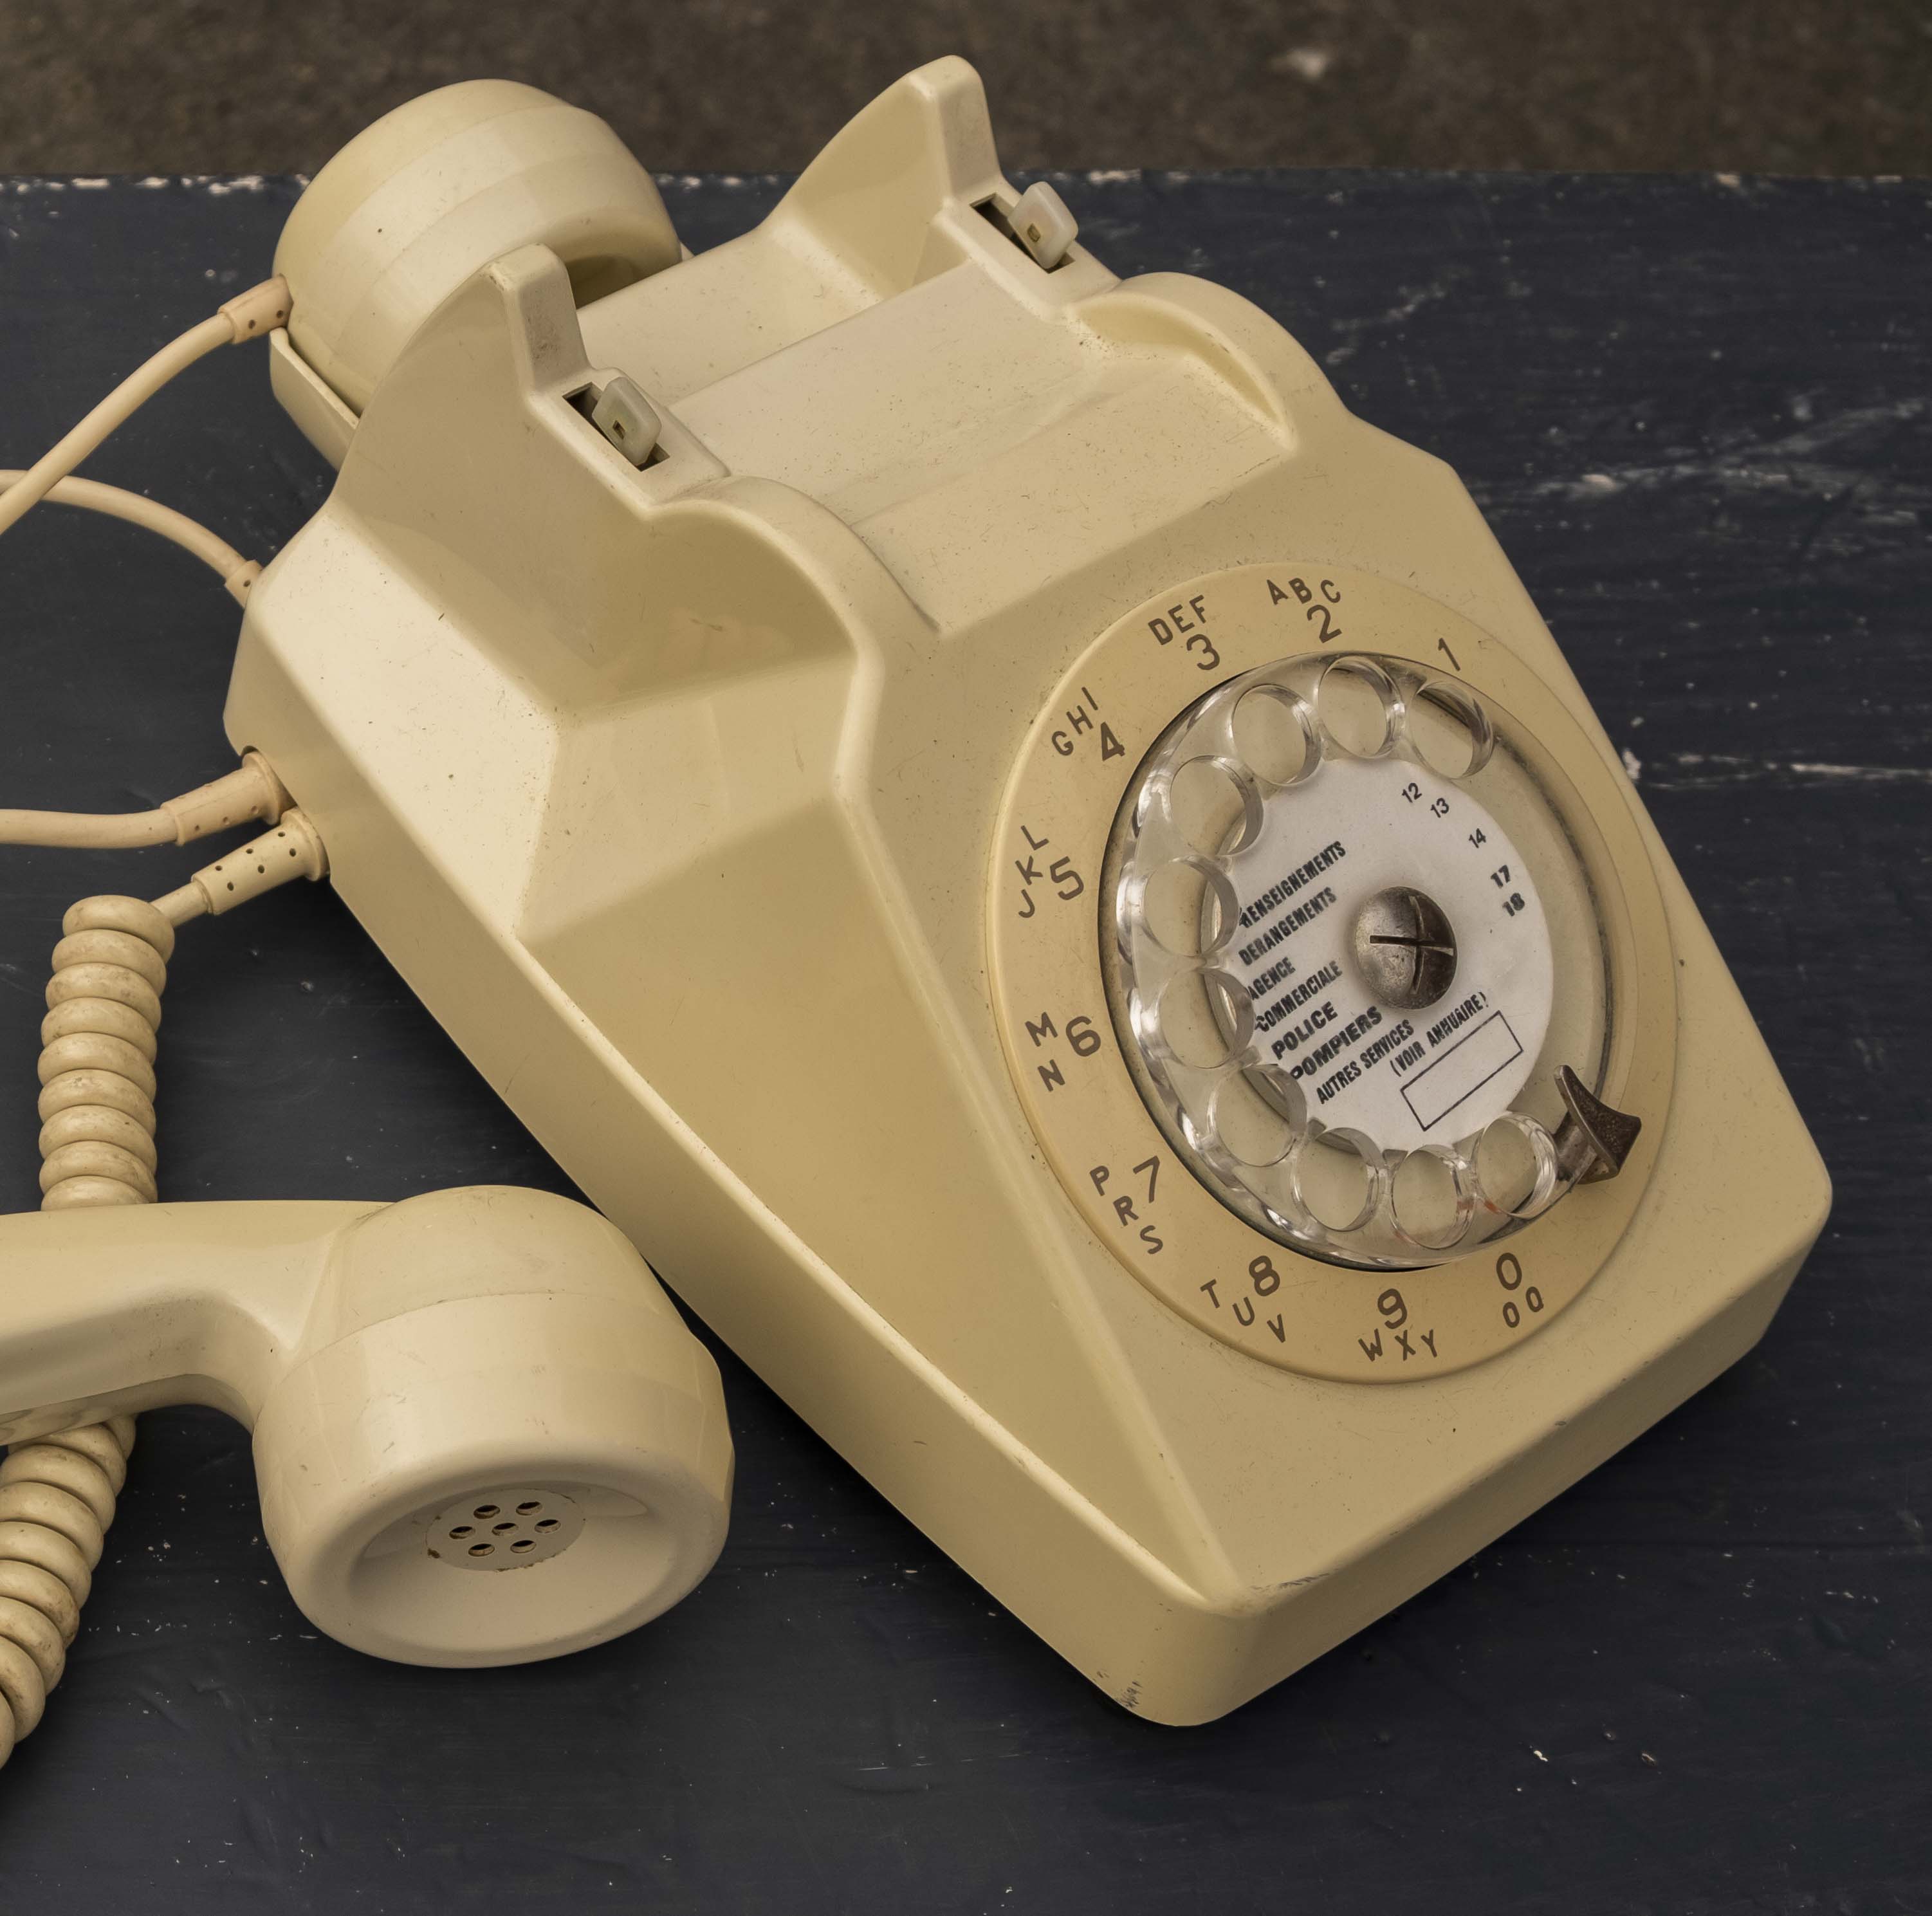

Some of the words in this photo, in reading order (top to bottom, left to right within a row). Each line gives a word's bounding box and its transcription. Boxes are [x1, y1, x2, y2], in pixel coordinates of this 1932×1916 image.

[1148, 595, 1210, 645] DEF
[1307, 603, 1342, 643] 2
[1186, 633, 1220, 670] 3
[1437, 638, 1460, 671] 1
[1099, 722, 1125, 761] 4
[1401, 782, 1423, 803] 12
[1430, 798, 1450, 818] 13
[1469, 828, 1486, 849] 14
[1050, 856, 1084, 901] 5
[1490, 865, 1511, 889] 17
[1502, 893, 1525, 917] 18
[1238, 886, 1336, 966] DERANGEMENTS
[1248, 957, 1296, 1000] AGENCE
[1255, 961, 1342, 1033] COMMERCIALE
[1065, 1016, 1101, 1056] 6
[1271, 1001, 1338, 1060] POLICE
[1290, 1006, 1383, 1080] POMPIERS
[1316, 1061, 1362, 1104] AUTRES
[1359, 1019, 1414, 1069] SERVICES
[1133, 1156, 1160, 1203] 7
[1249, 1255, 1280, 1296] 8
[1496, 1253, 1522, 1291] 0
[1377, 1288, 1408, 1329] 9
